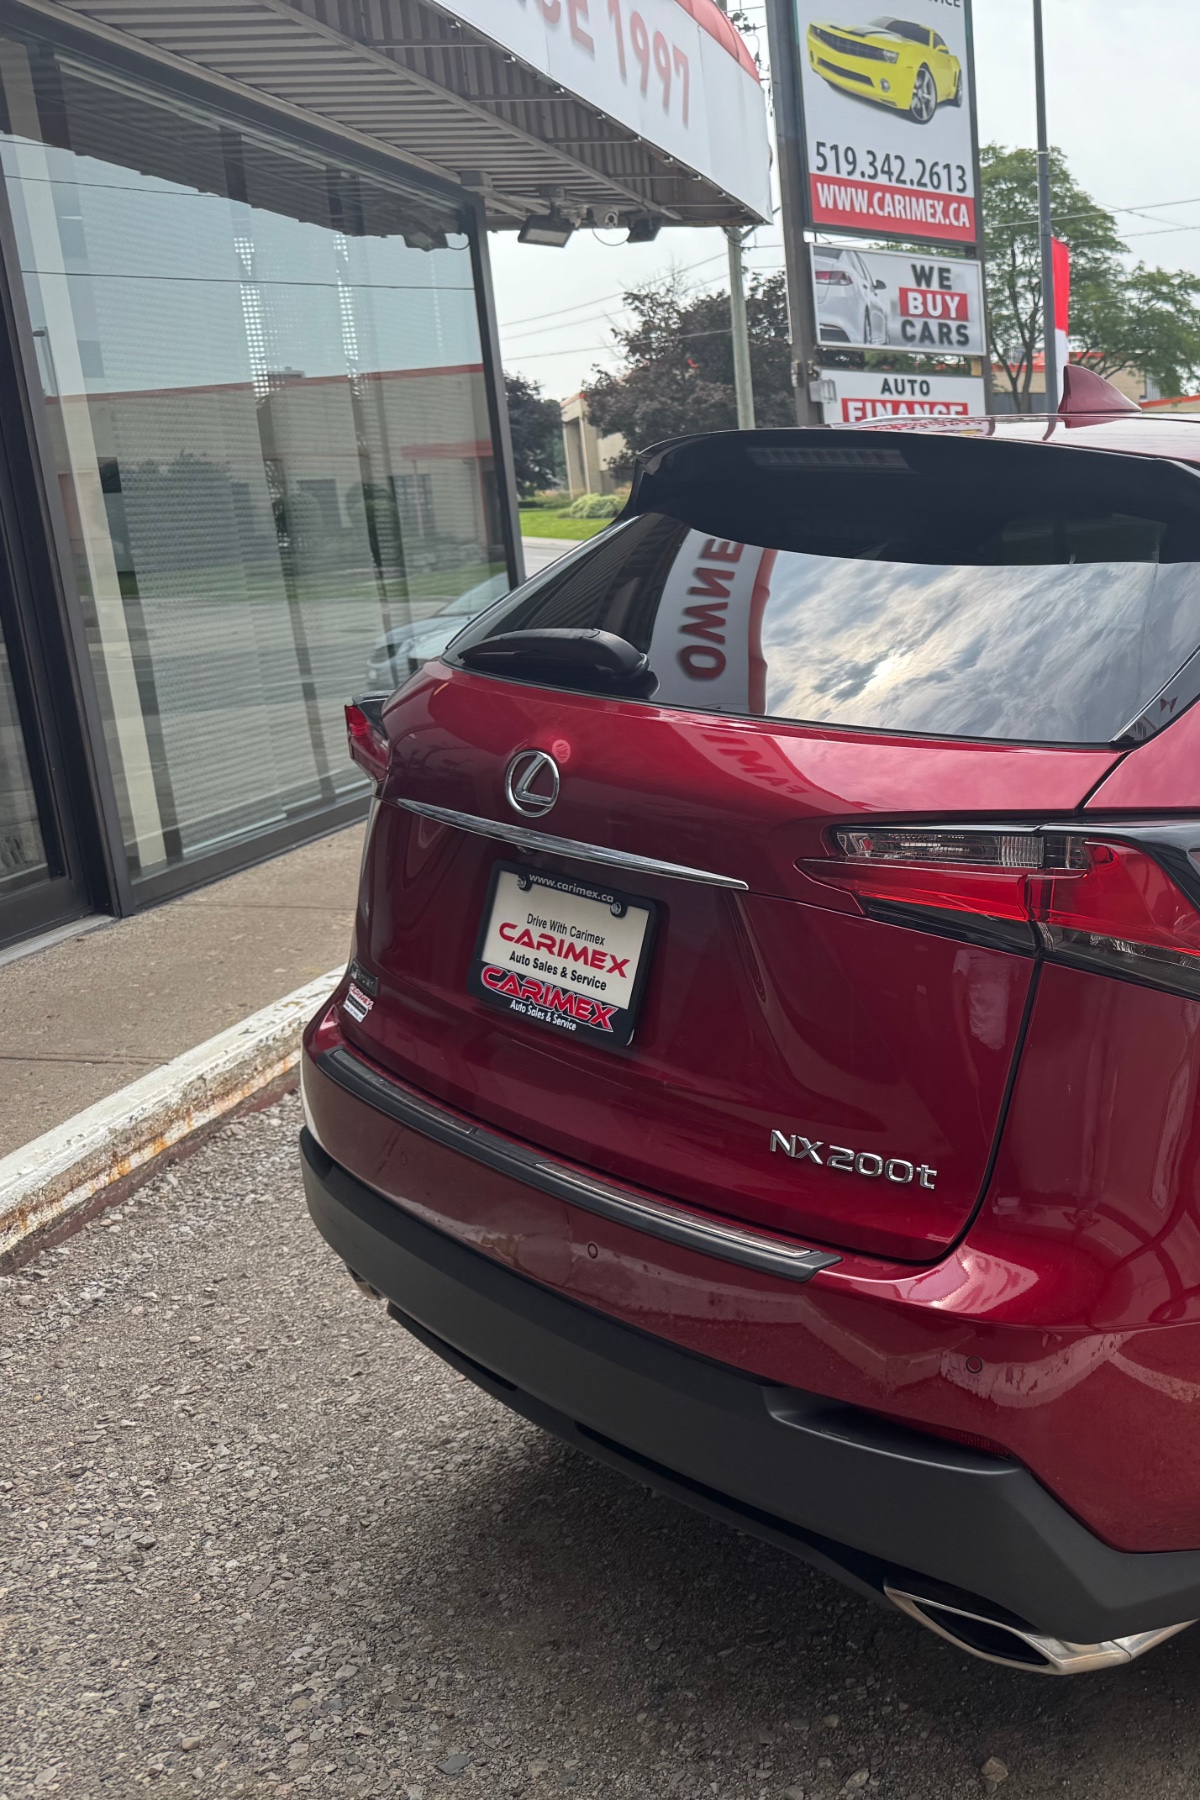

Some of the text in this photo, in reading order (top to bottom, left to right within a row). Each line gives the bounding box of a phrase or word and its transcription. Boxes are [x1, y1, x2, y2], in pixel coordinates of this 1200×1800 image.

[608, 0, 690, 125] 1997
[815, 141, 968, 193] 519.342.2613
[816, 182, 970, 228] WWW.CARIMEX.CA
[911, 264, 952, 290] WE
[907, 291, 960, 318] BUY
[901, 319, 970, 346] CARS
[881, 378, 930, 396] AUTO
[529, 874, 614, 903] www.carimex.ca
[526, 913, 606, 946] Drive With Carimex
[499, 922, 631, 979] CARIMEX
[509, 950, 607, 991] Auto Sales & Service
[481, 965, 616, 1031] CARIMEX
[510, 999, 577, 1031] Auto Sales & Service
